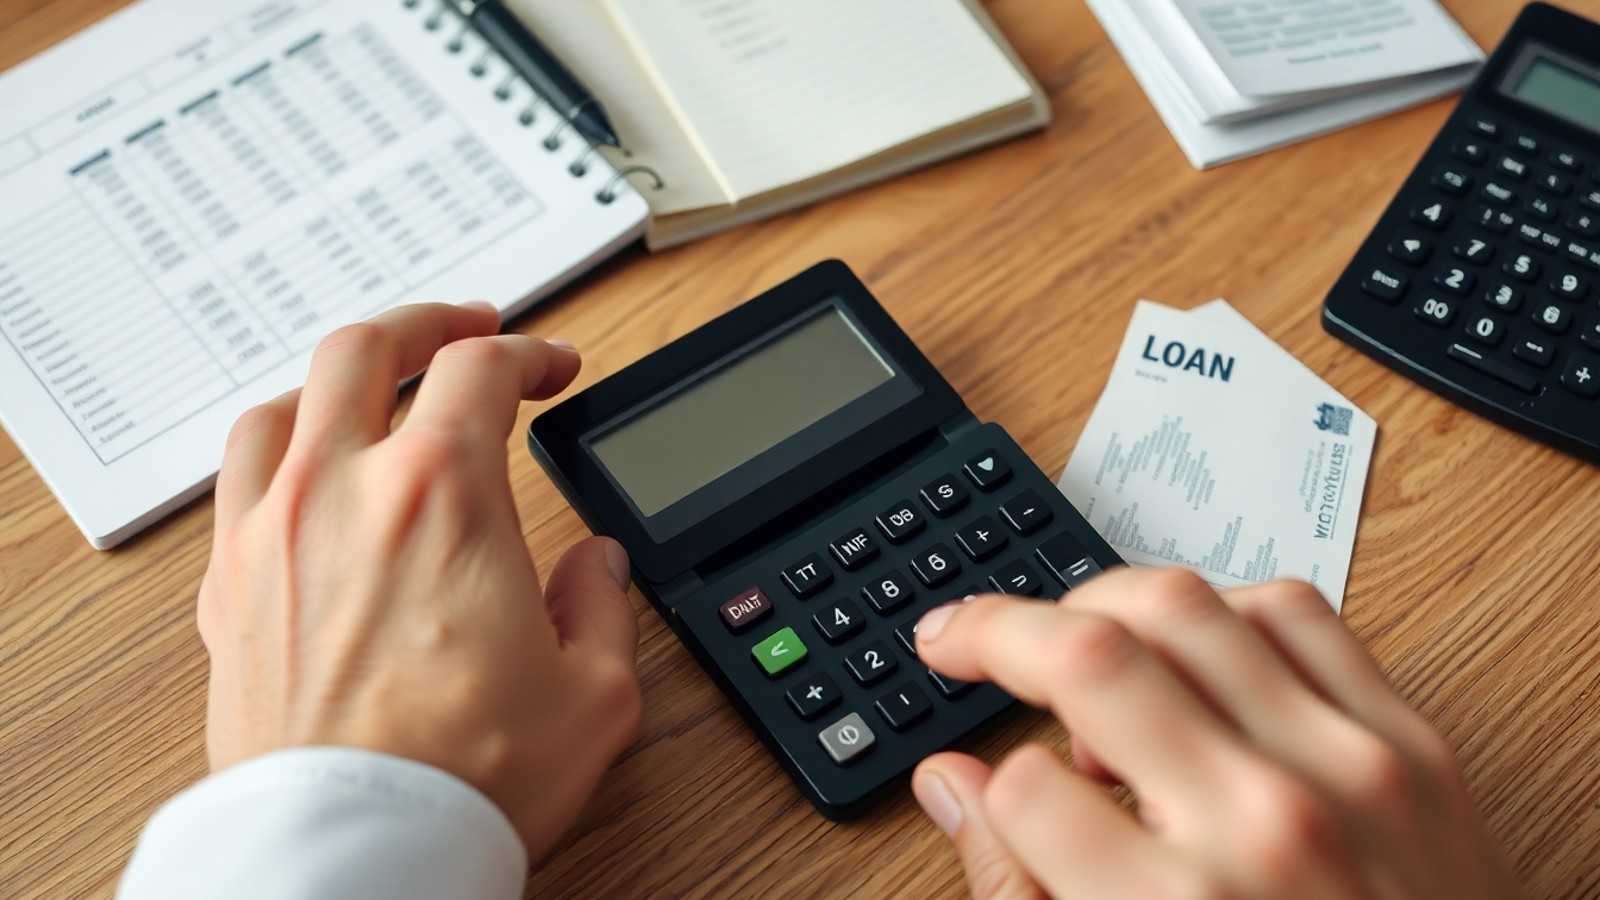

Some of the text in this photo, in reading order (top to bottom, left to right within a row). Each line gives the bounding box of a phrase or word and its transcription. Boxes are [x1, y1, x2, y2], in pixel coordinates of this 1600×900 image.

[1468, 240, 1485, 256] 7
[1446, 269, 1464, 288] 2
[1496, 286, 1512, 304] 3
[1477, 319, 1493, 336] 0
[1143, 335, 1234, 381] LOAN
[882, 581, 899, 597] 8
[835, 608, 849, 624] 4
[865, 651, 884, 669] 2
